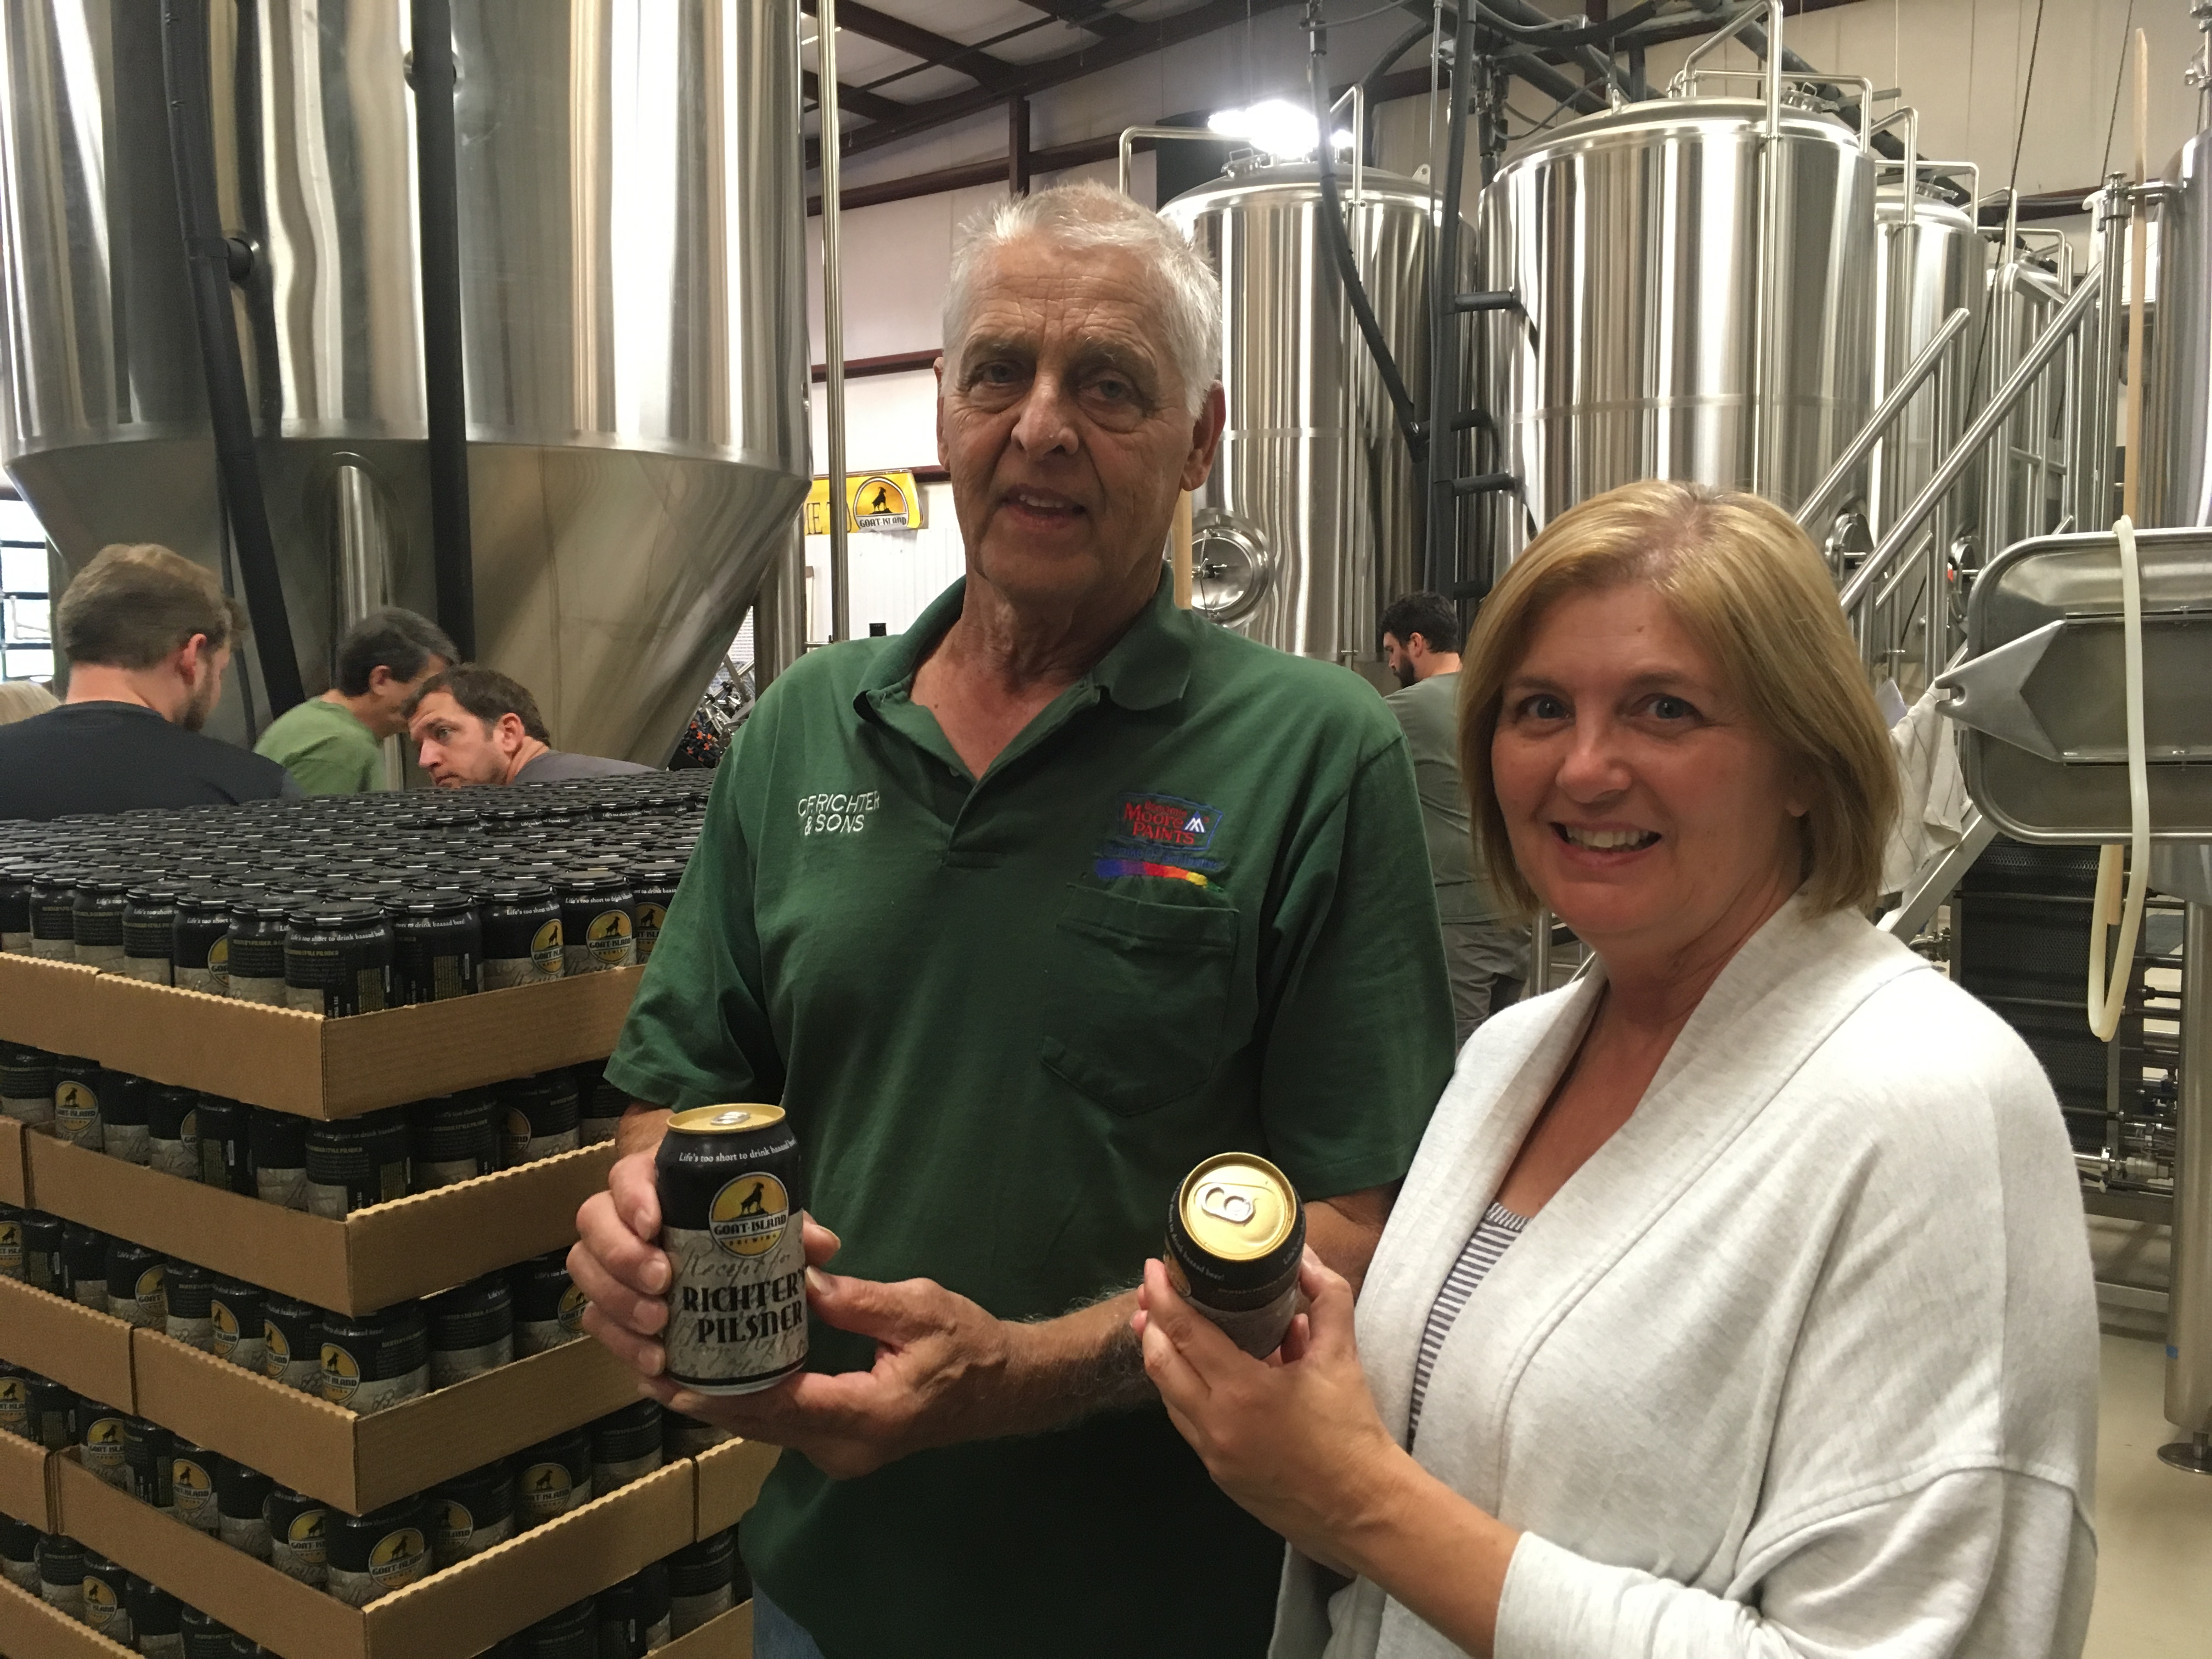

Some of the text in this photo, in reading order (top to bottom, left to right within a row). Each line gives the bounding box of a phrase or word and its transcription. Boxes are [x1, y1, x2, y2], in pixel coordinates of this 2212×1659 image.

[860, 518, 881, 527] GOAT
[1124, 802, 1184, 829] Moore
[1144, 800, 1187, 817] Benjamin
[804, 814, 865, 836] & SONS
[1132, 821, 1195, 845] PAINTS
[589, 937, 631, 949] GOAT ISLAND
[534, 951, 552, 960] GOAT
[679, 1153, 698, 1162] Life's
[715, 1153, 737, 1162] short
[750, 1147, 770, 1158] drink
[714, 1214, 787, 1235] GOAT ISLAND
[729, 1234, 777, 1246] BREWING
[697, 1300, 803, 1343] PILSNER
[331, 1377, 357, 1386] ISLAND
[543, 1489, 569, 1500] ISLAND
[372, 1553, 424, 1575] GOAT ISLAND
